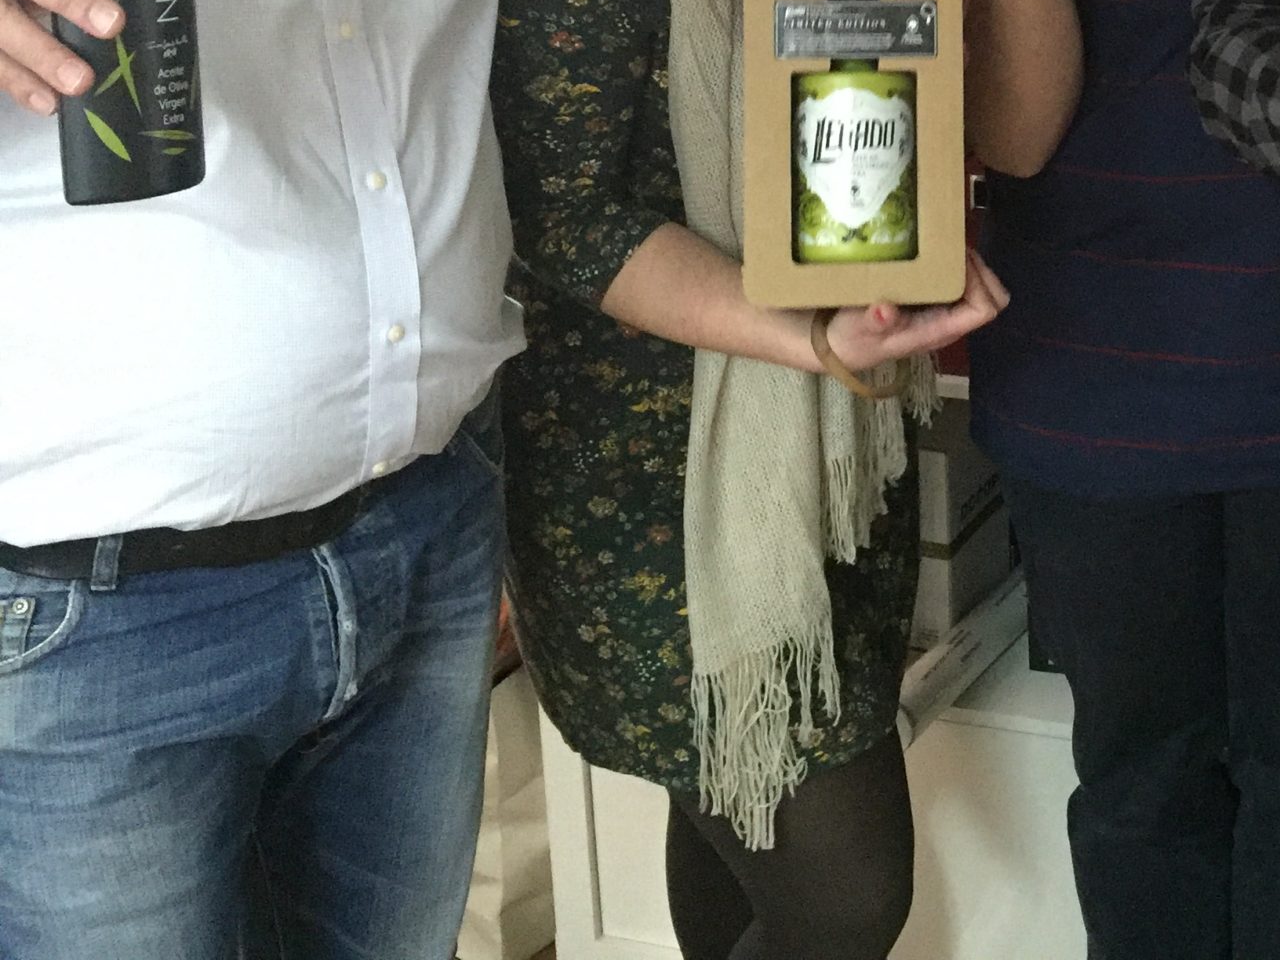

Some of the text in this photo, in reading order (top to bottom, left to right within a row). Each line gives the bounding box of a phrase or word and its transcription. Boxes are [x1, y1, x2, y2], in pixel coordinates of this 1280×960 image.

[153, 84, 167, 96] de
[158, 97, 187, 110] Virgen
[163, 113, 185, 125] Extra
